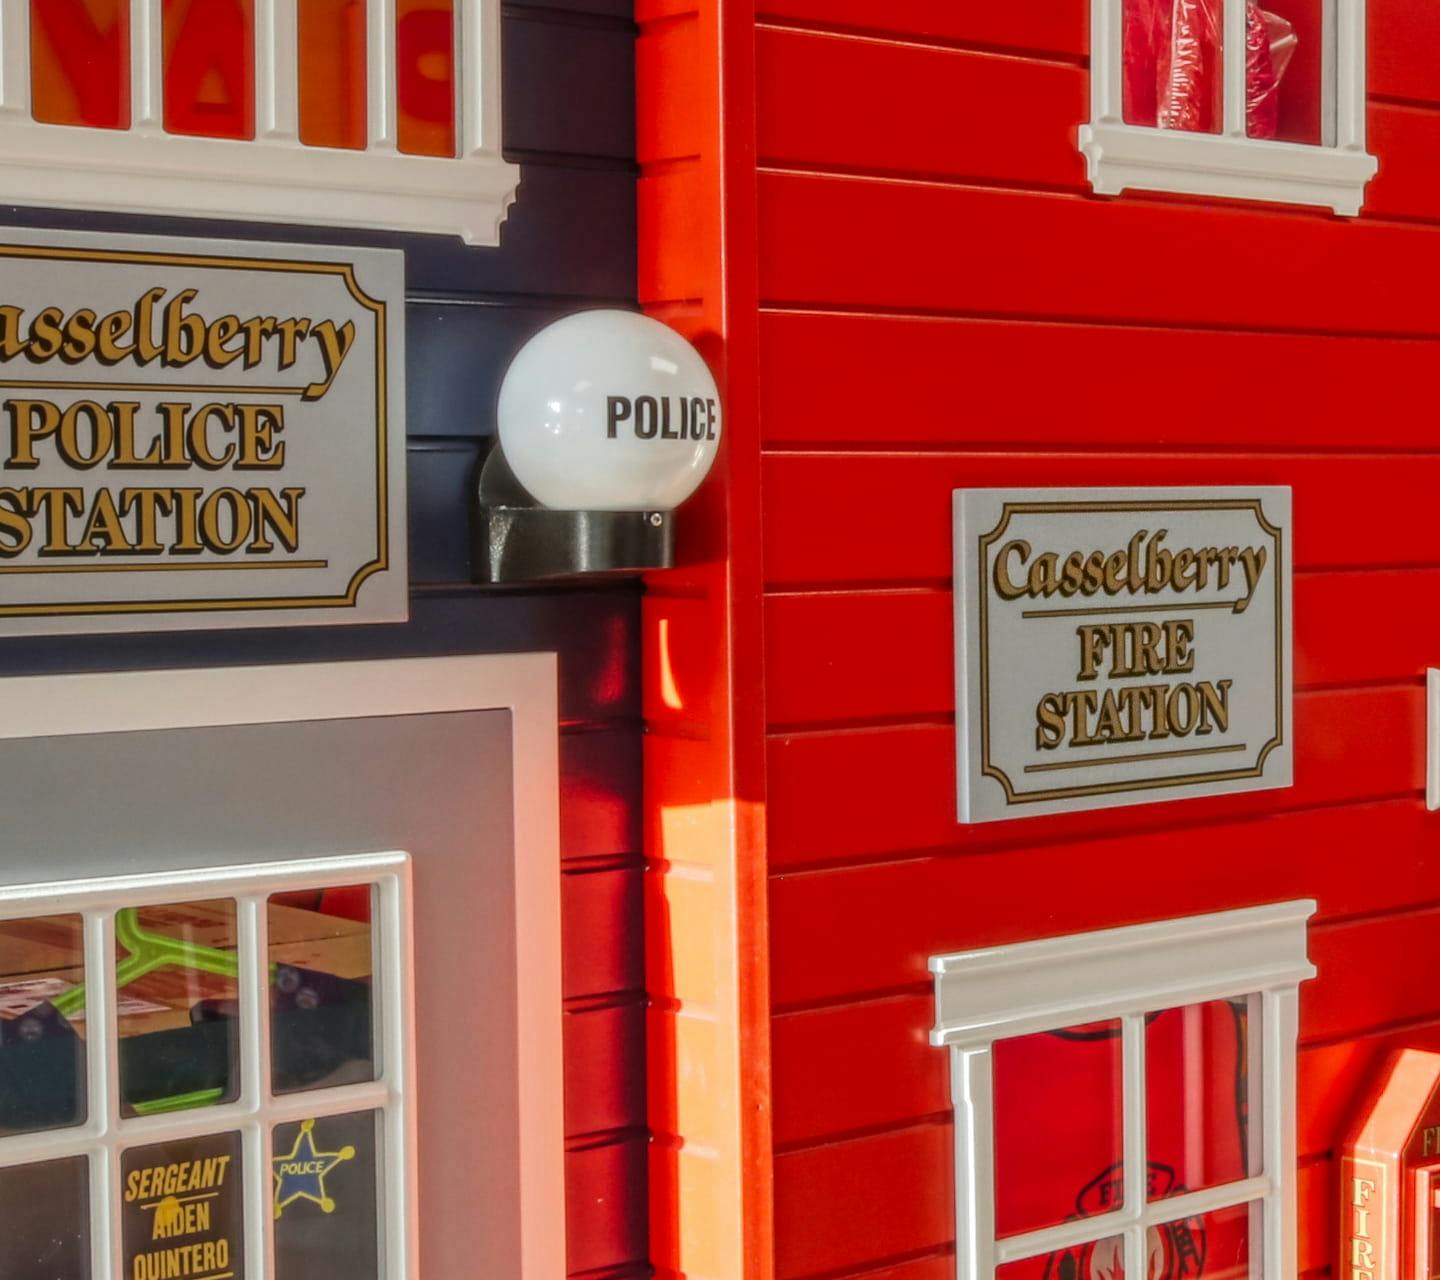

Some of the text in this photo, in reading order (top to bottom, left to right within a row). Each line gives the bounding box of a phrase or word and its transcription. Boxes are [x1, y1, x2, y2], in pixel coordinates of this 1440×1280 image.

[4, 399, 286, 471] POLICE
[605, 394, 717, 441] POLICE
[993, 528, 1267, 615] Casselberry
[1076, 619, 1195, 682] FIRE
[1035, 679, 1234, 752] STATION
[124, 1155, 231, 1202] SERGEANT
[279, 1160, 326, 1176] POLICE
[151, 1200, 210, 1241] AIDEN
